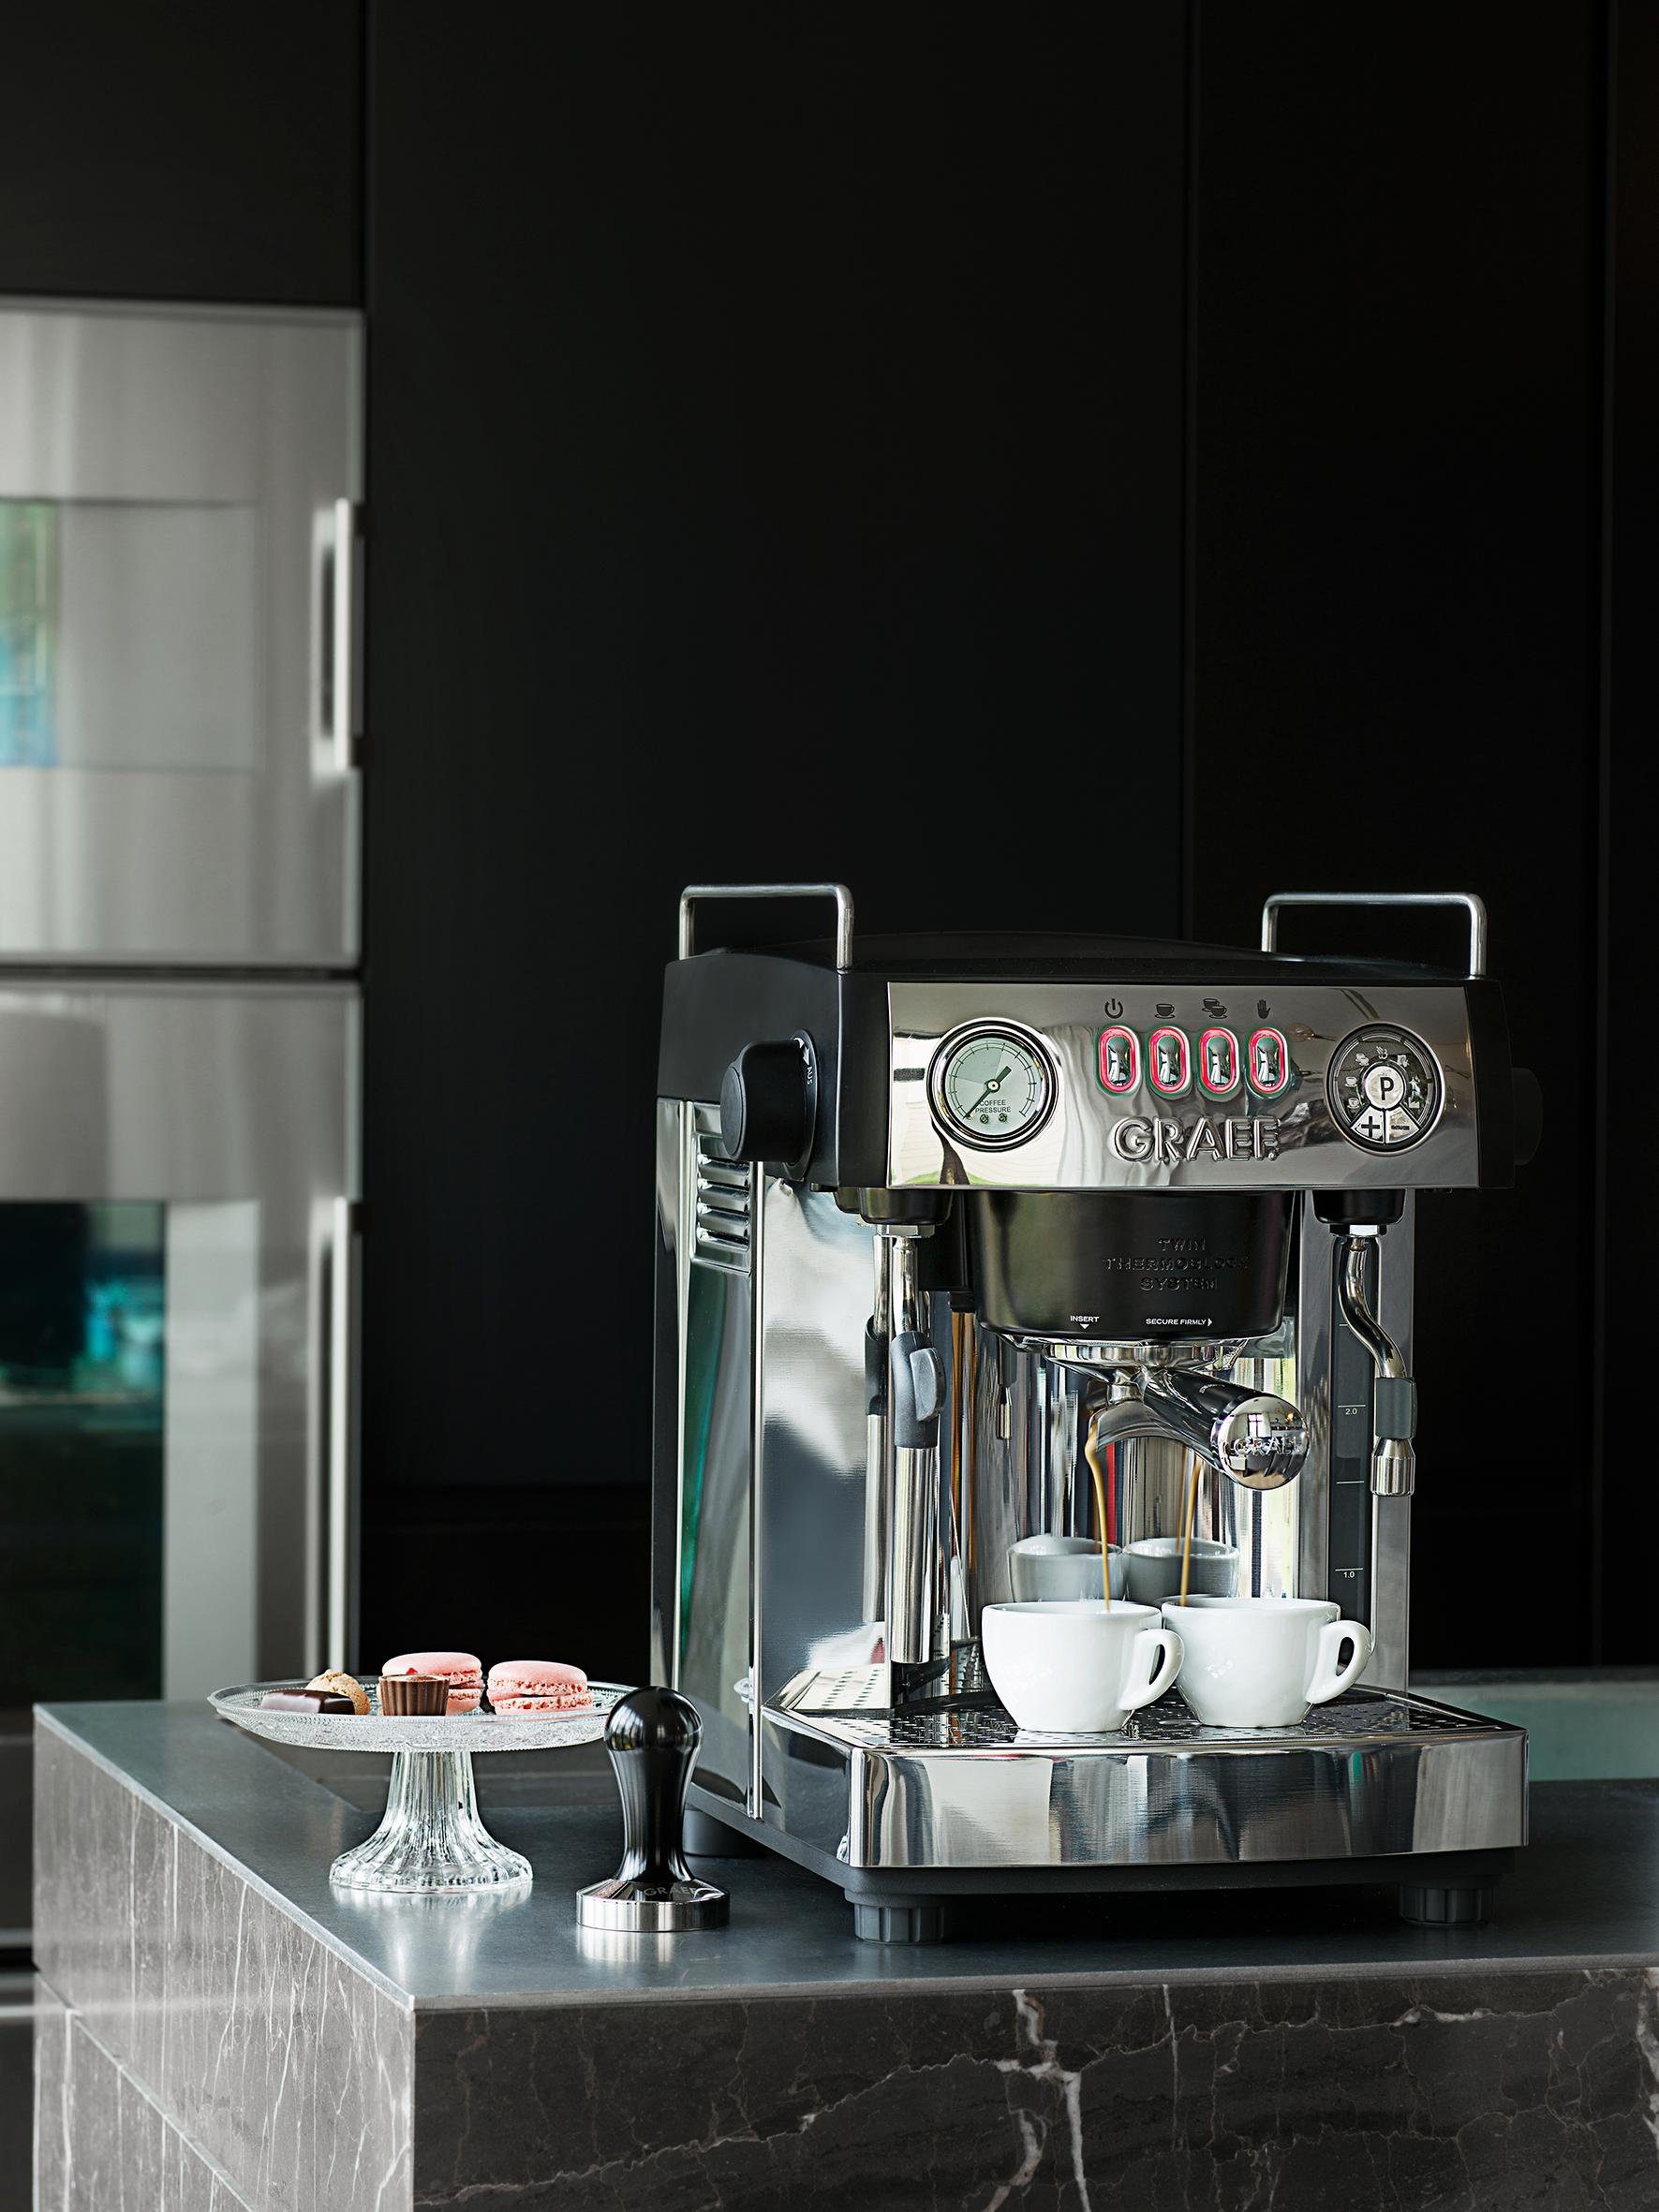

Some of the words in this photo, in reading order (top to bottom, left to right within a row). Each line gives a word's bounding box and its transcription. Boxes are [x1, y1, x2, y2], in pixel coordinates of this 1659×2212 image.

[1380, 1077, 1395, 1100] P
[1157, 1237, 1207, 1252] TWIN
[1140, 1276, 1218, 1291] SYSTEM
[1070, 1315, 1100, 1324] INSERT
[1145, 1318, 1178, 1326] SECURE
